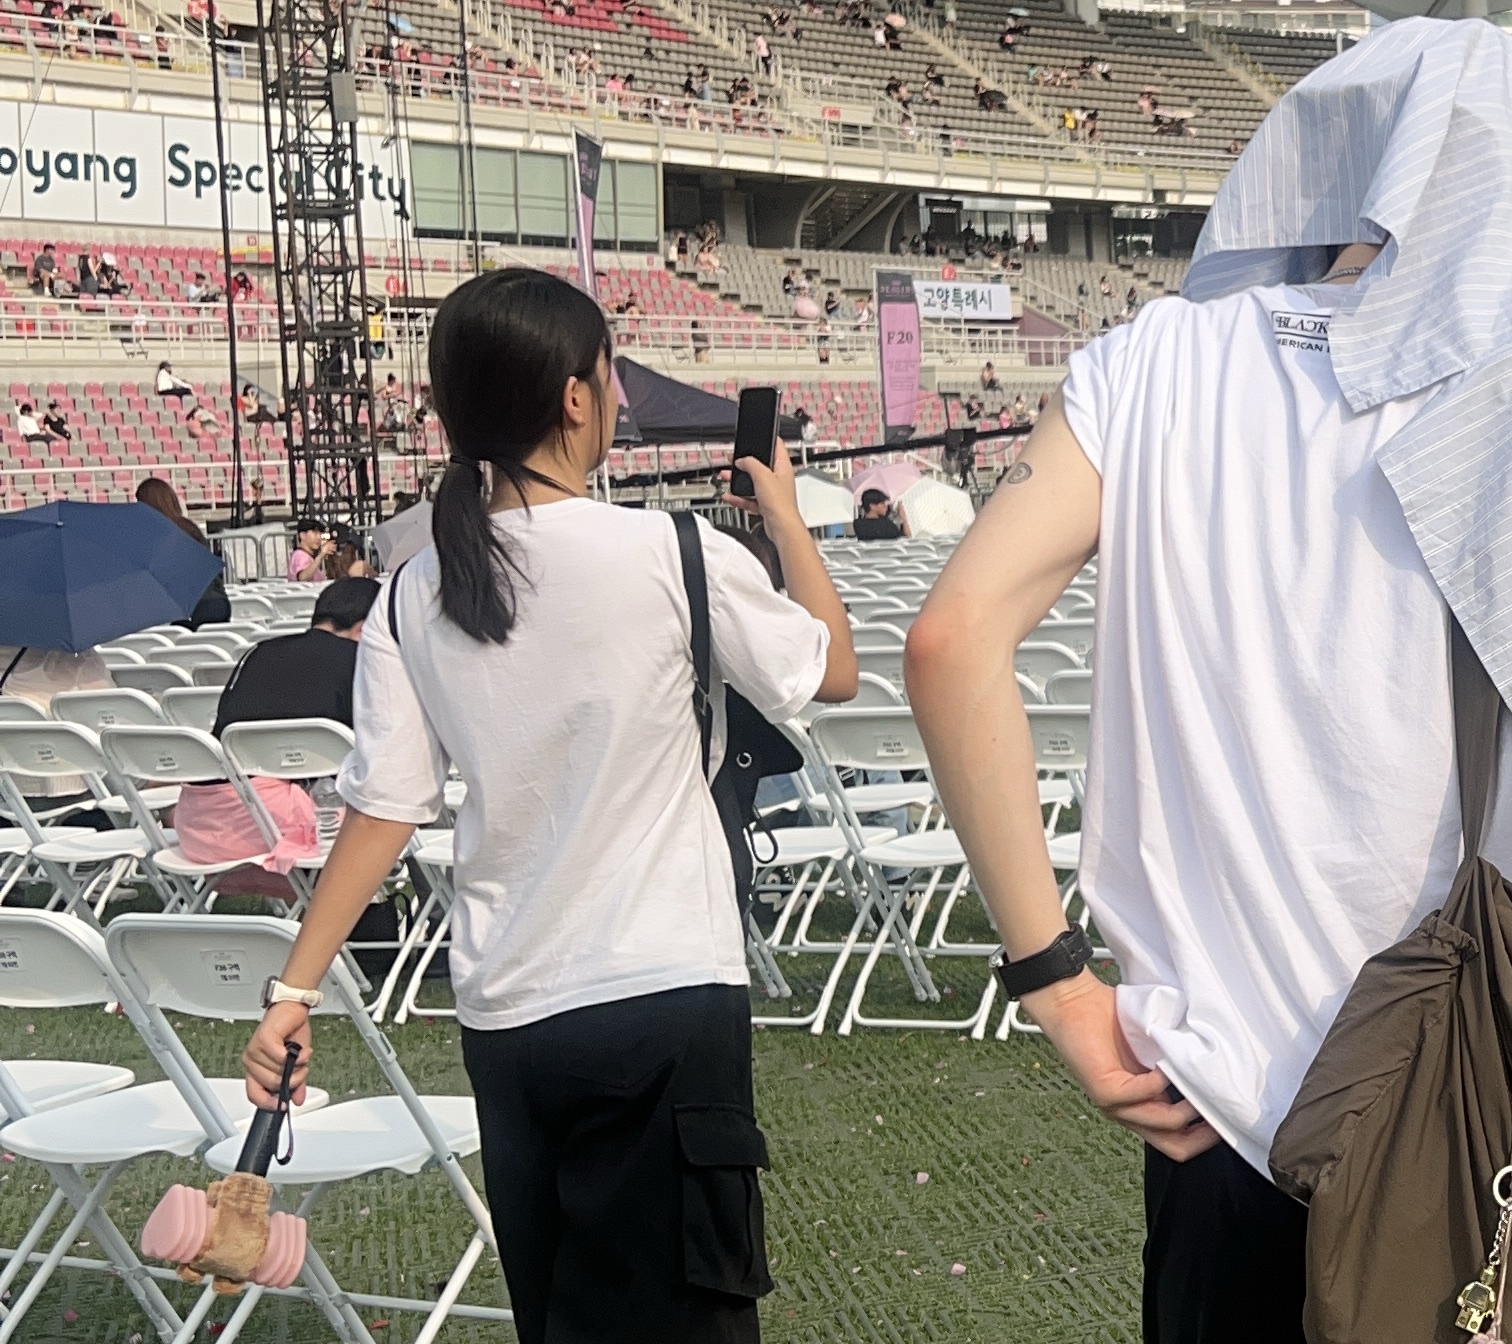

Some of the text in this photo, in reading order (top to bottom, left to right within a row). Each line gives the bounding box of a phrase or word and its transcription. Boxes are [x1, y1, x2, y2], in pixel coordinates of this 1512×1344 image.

[167, 143, 314, 199] Specal
[923, 287, 993, 312] 고양특례시
[887, 331, 914, 345] F20
